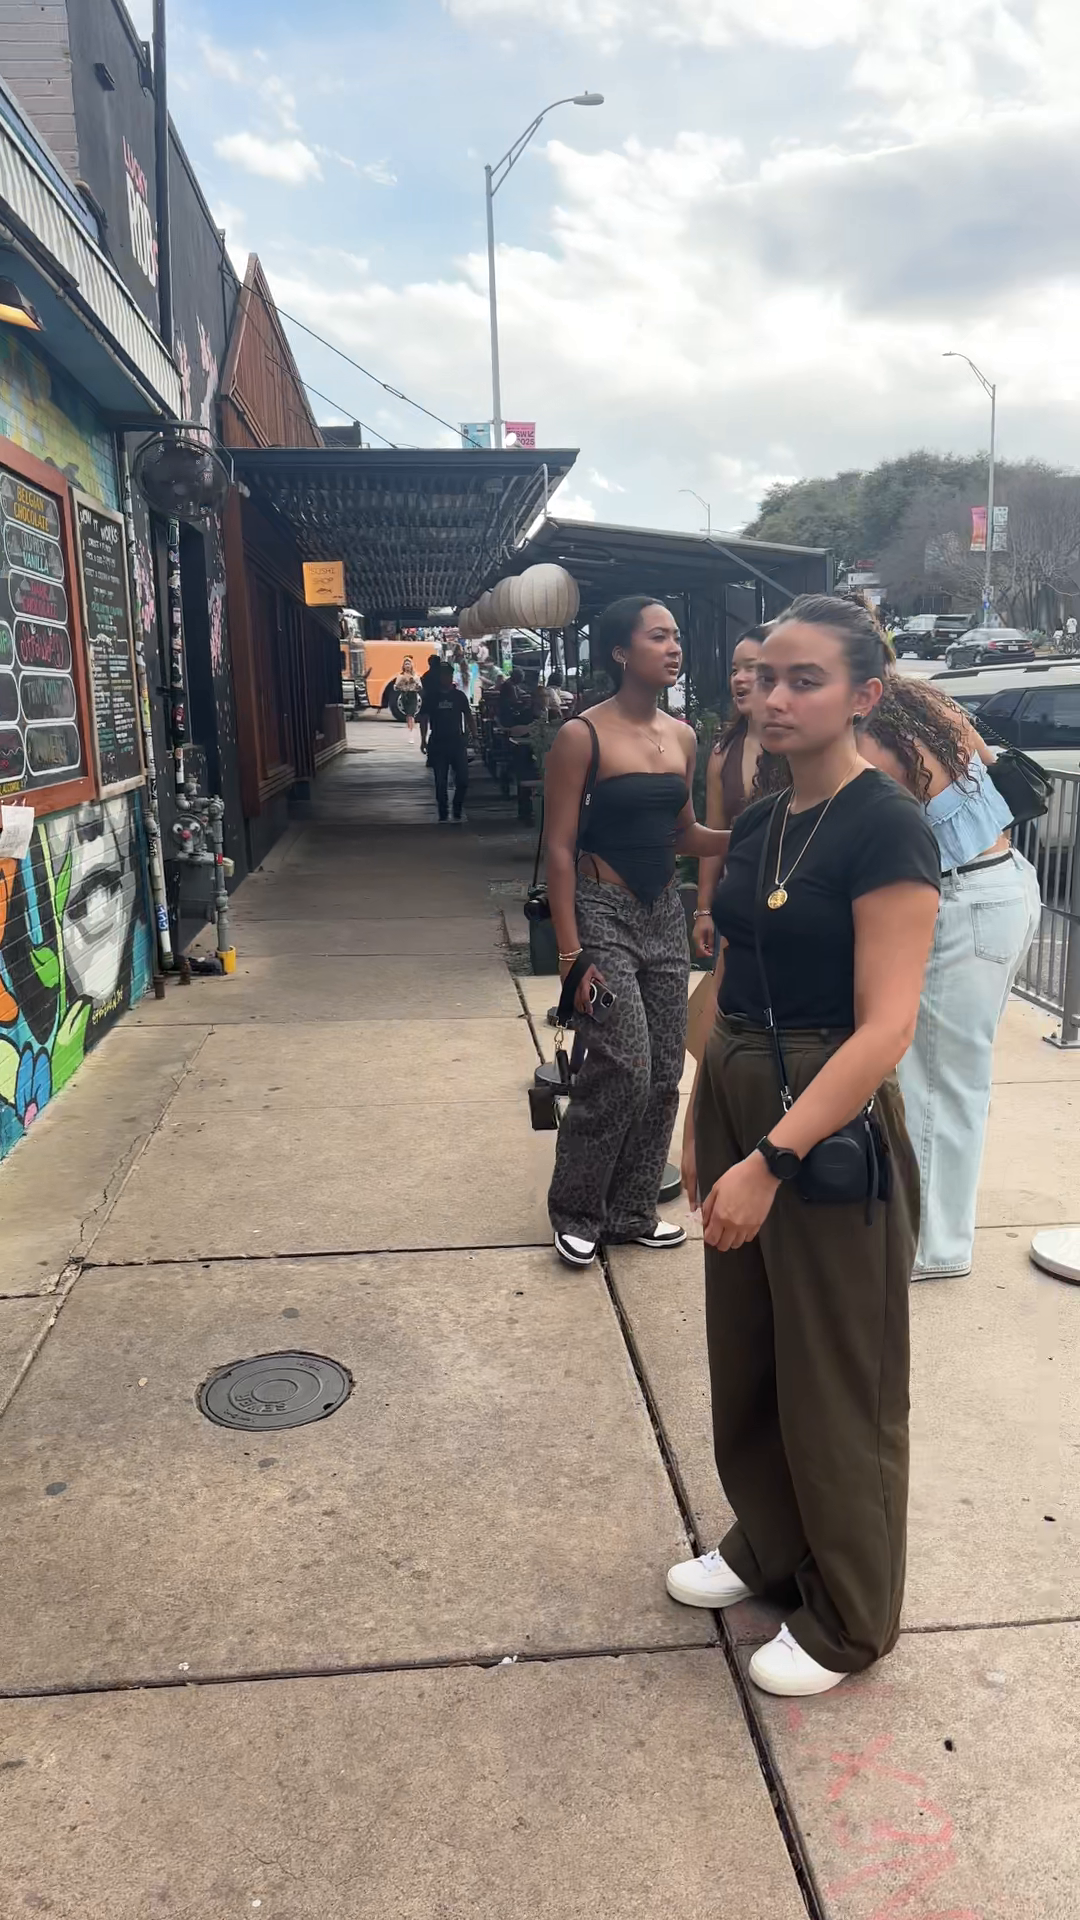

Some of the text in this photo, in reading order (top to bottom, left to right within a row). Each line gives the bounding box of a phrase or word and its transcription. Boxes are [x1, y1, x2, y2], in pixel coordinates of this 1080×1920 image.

[16, 485, 44, 512] BELGIAN
[13, 502, 49, 532] CHOCOLATE
[22, 551, 49, 574] VANILLA
